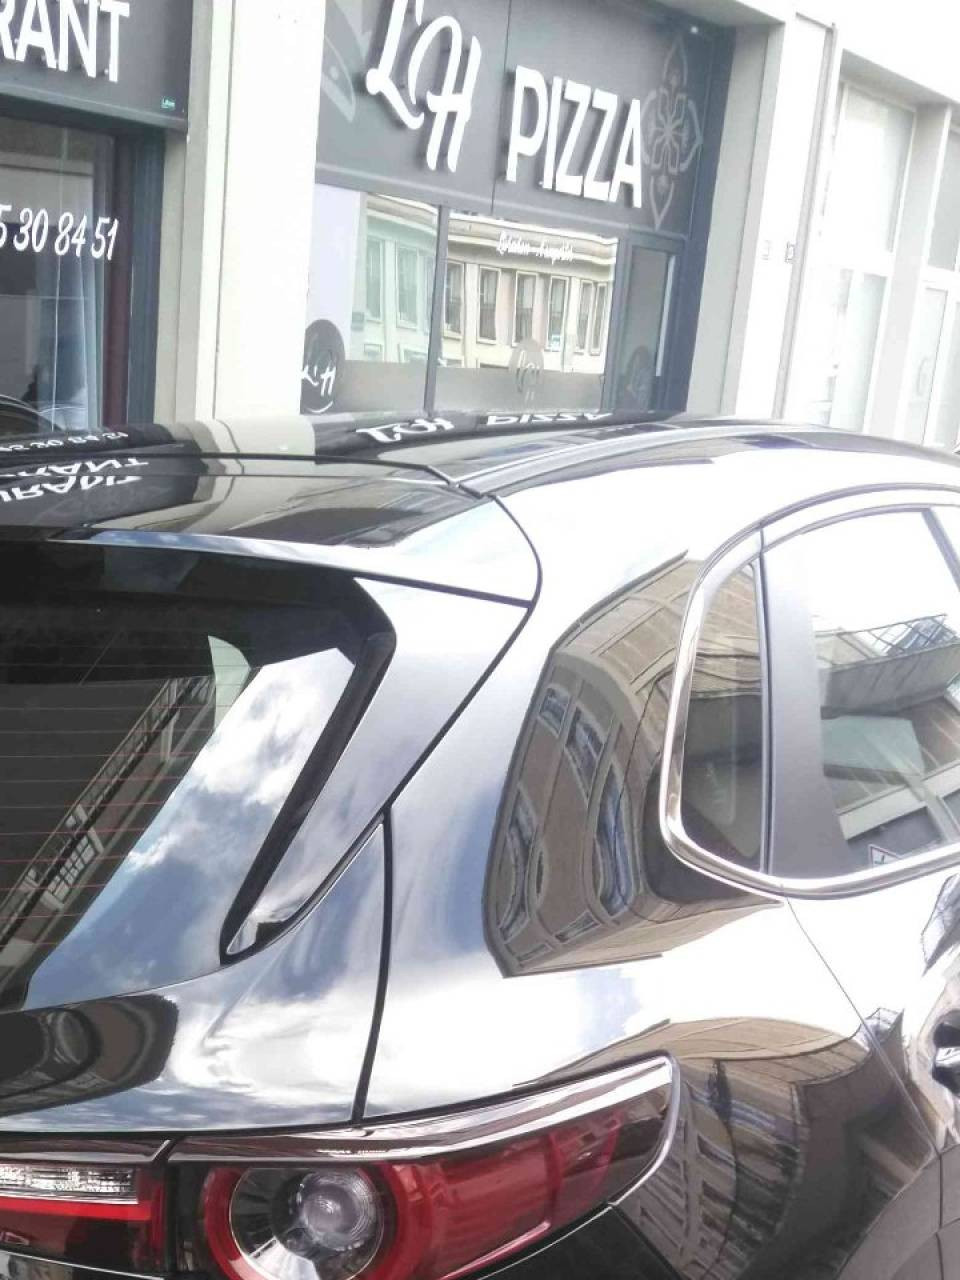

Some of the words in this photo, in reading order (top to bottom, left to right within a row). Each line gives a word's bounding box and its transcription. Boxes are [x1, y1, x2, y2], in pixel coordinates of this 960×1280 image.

[506, 65, 642, 208] PIZZA
[13, 207, 49, 252] 30
[54, 212, 87, 257] 84
[91, 216, 119, 260] 51
